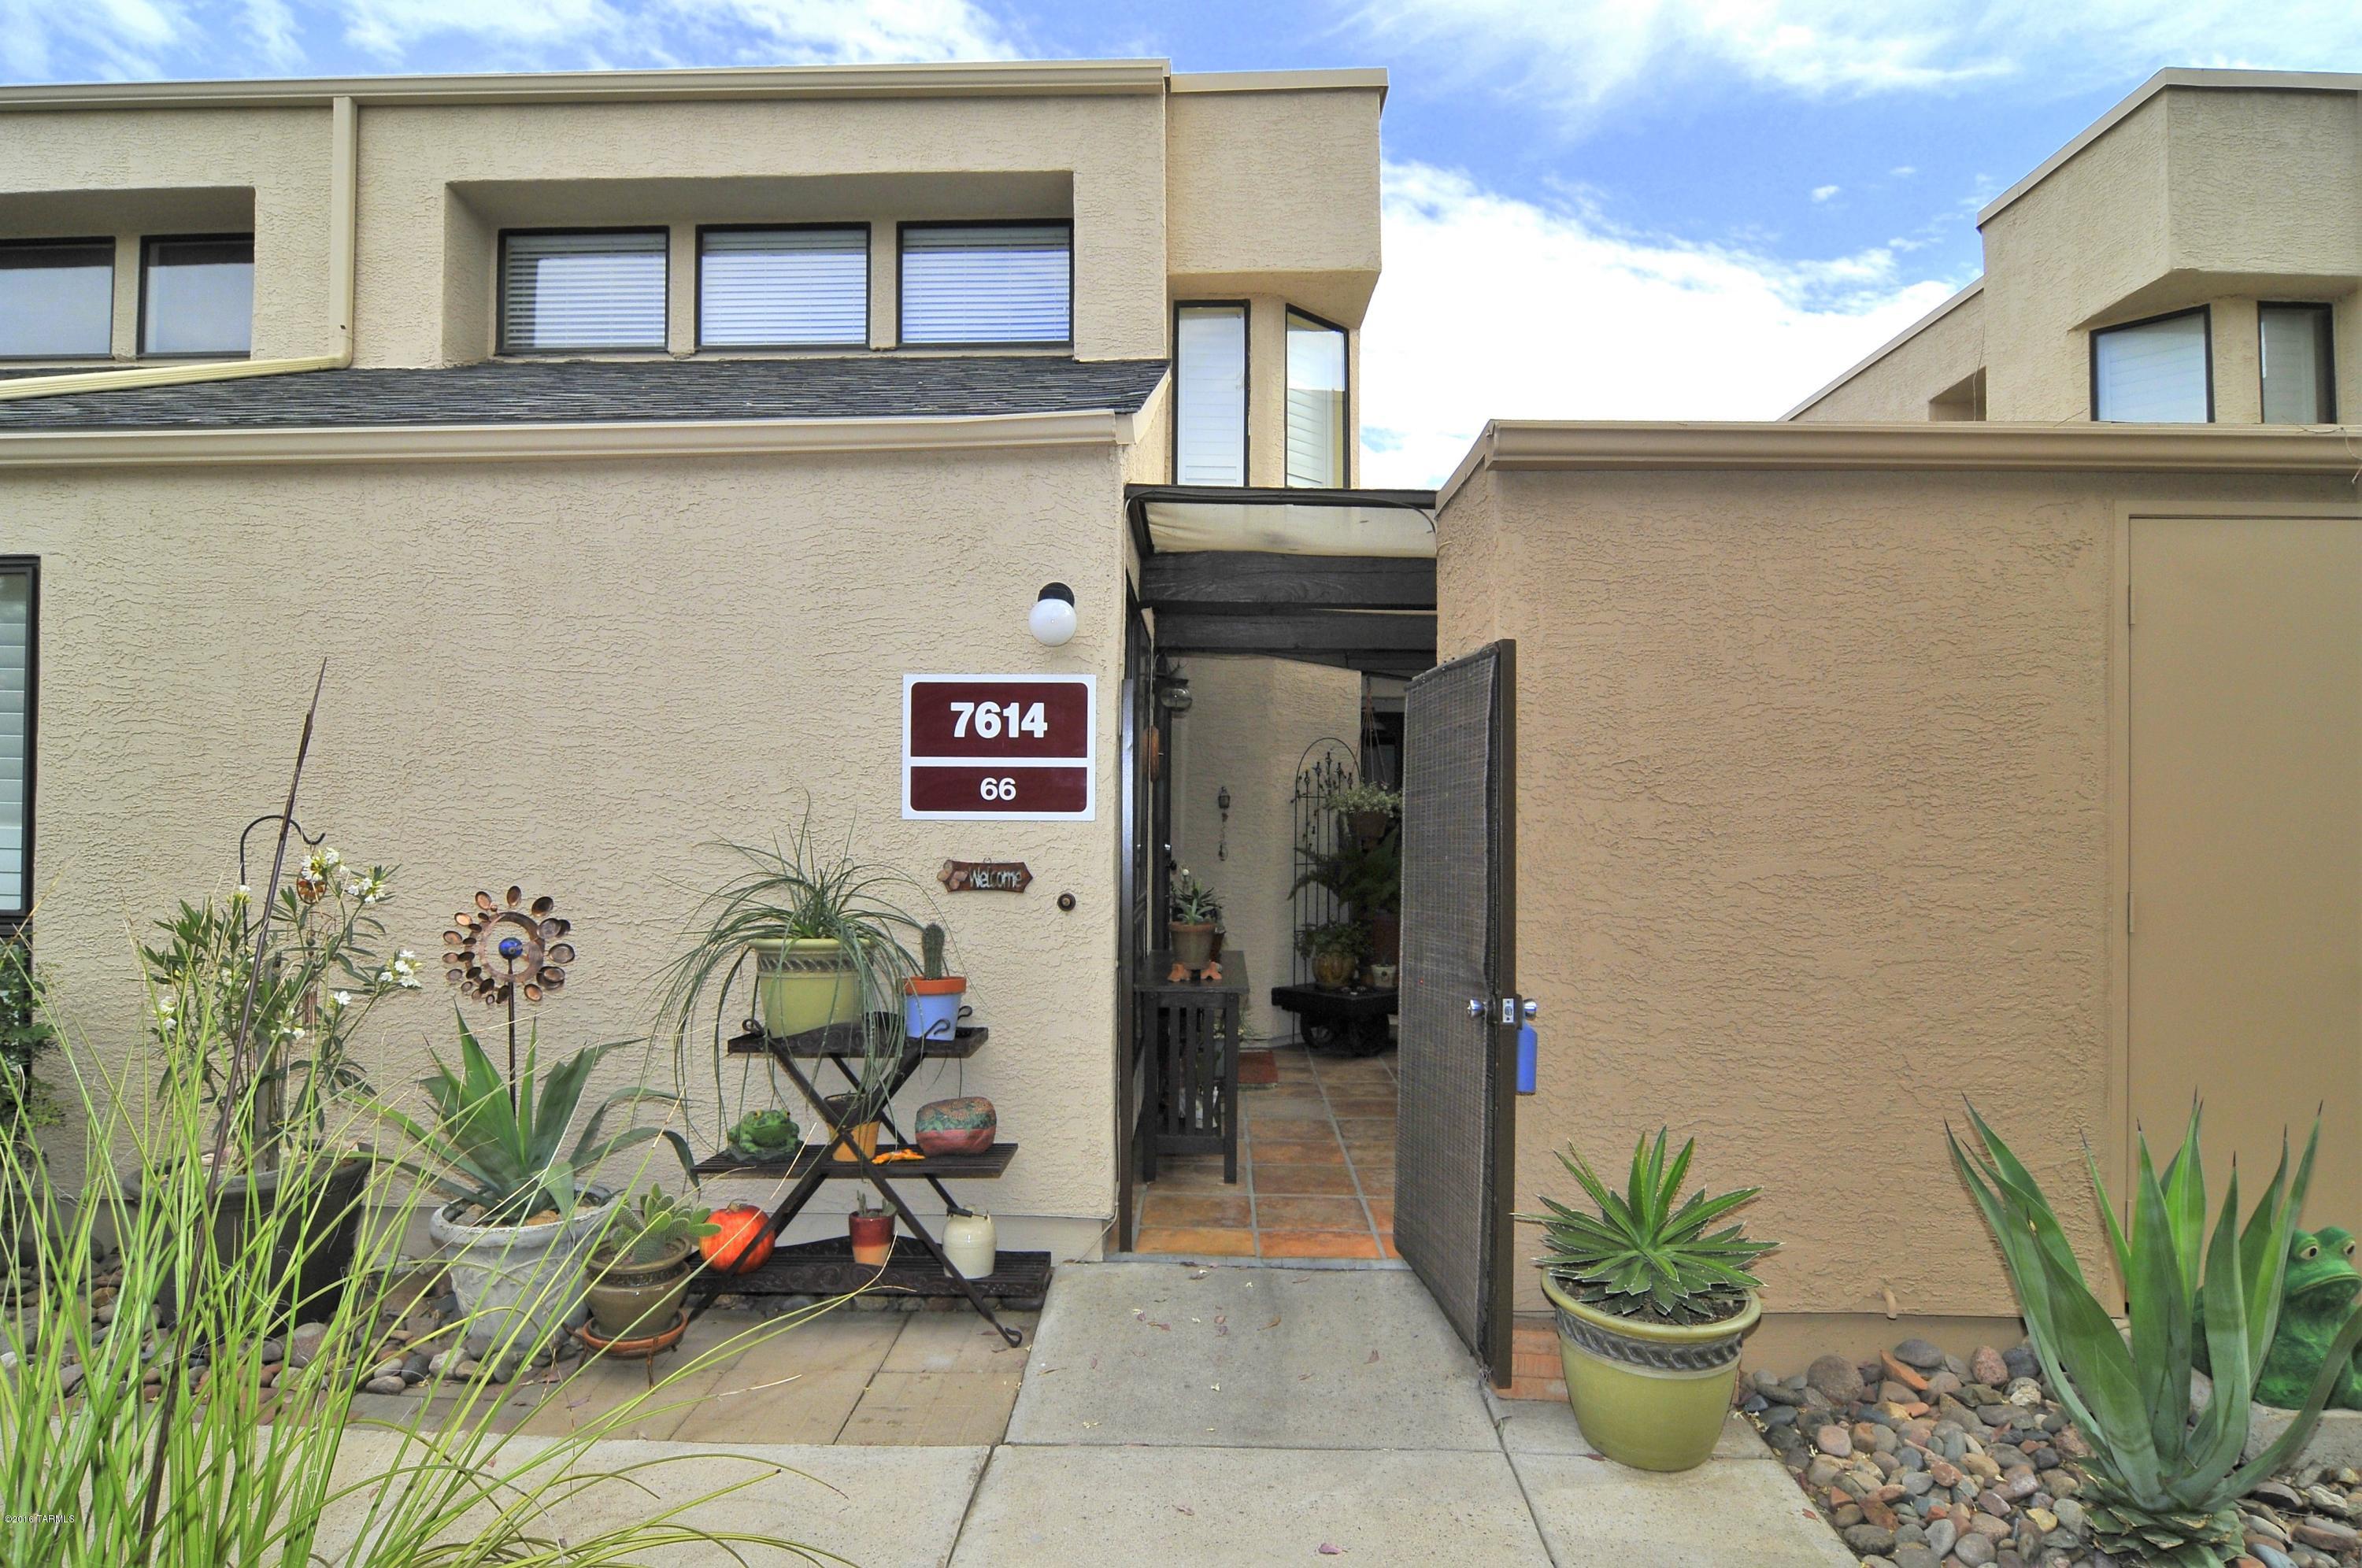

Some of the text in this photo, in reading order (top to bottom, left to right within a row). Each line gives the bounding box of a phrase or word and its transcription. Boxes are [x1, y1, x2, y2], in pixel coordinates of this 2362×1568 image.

[950, 701, 1048, 738] 7614
[980, 777, 1016, 801] 66
[969, 867, 1021, 889] Welcome
